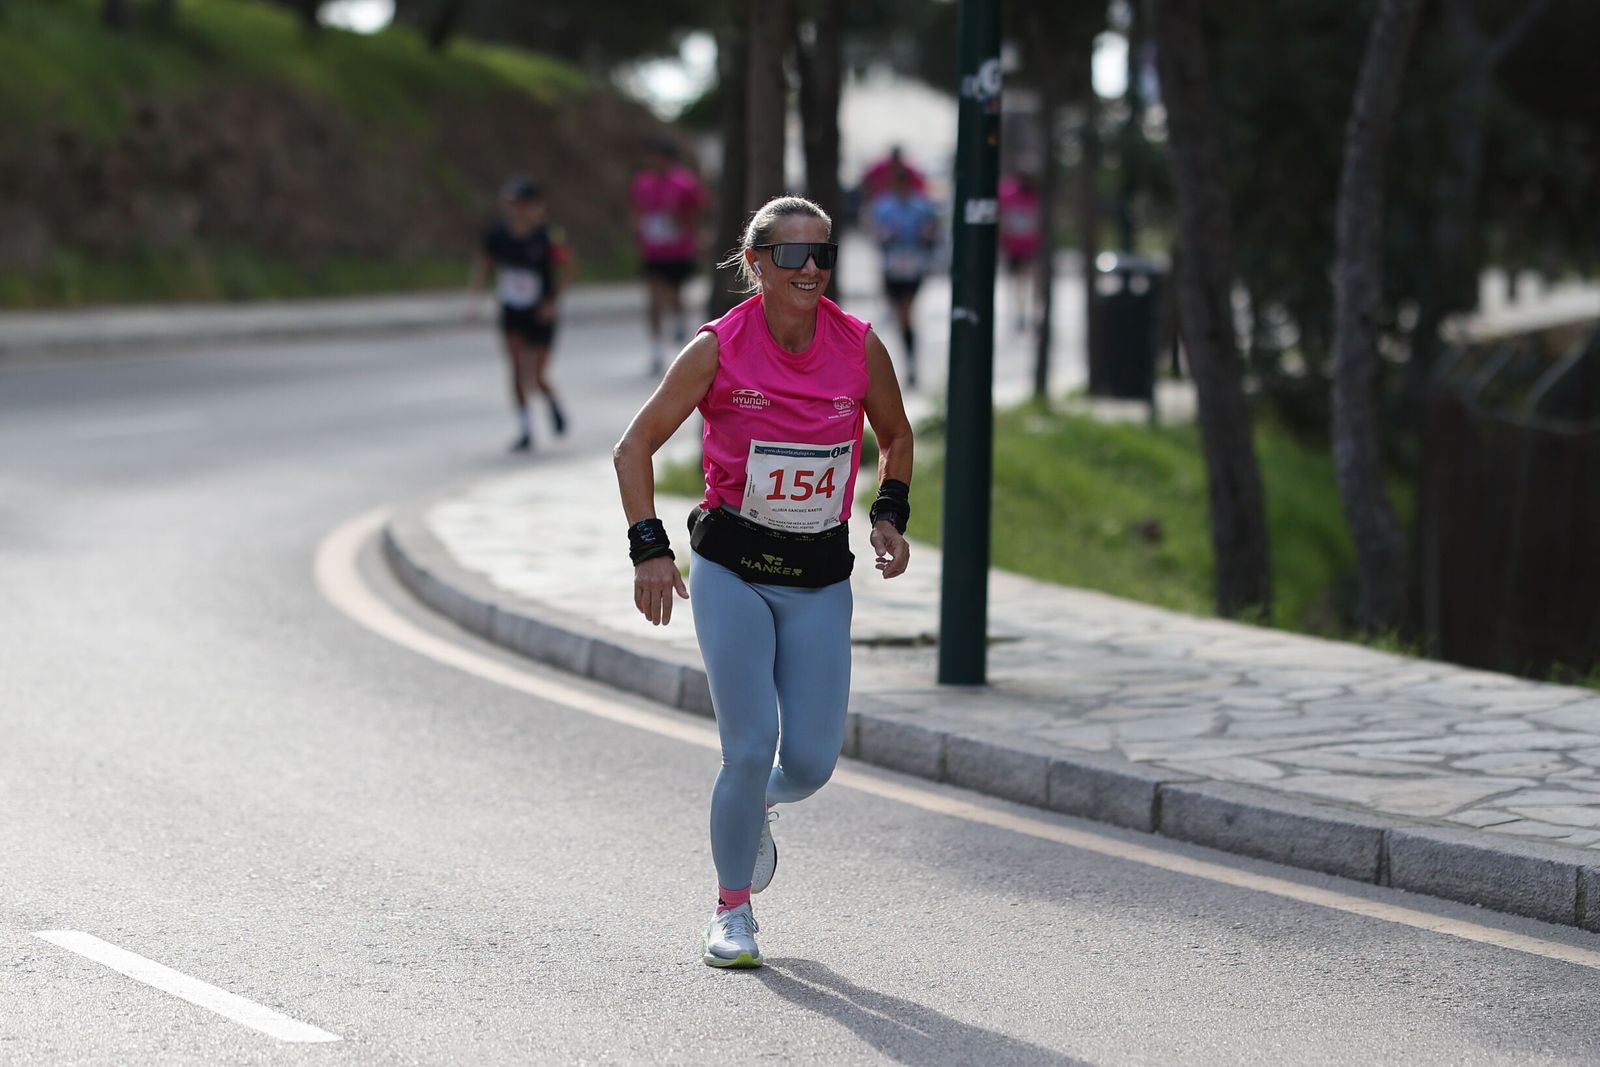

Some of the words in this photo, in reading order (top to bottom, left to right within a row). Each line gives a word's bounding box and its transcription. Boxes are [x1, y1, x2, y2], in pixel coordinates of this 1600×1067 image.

[732, 396, 770, 406] HYUNDAI
[766, 466, 835, 501] 154
[740, 556, 803, 577] HANKER
